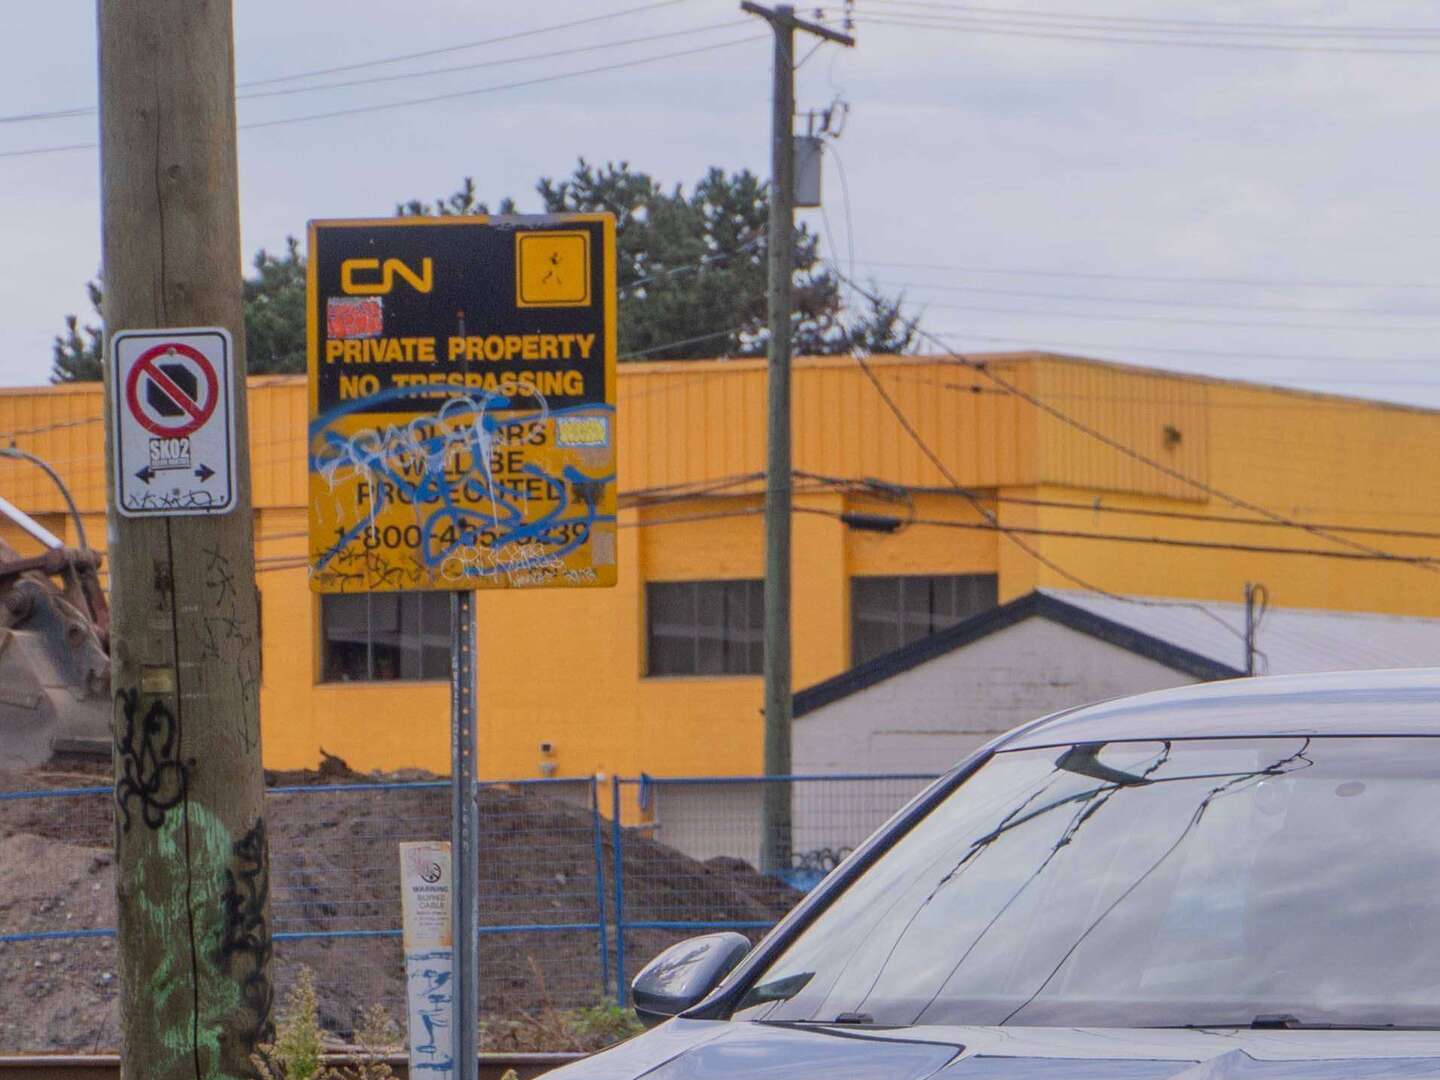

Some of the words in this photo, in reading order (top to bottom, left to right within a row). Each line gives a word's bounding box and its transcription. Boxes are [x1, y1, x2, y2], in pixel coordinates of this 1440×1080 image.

[341, 257, 433, 294] CN
[326, 337, 437, 364] PRIVATE
[447, 334, 595, 362] PROPERTY
[339, 374, 380, 400] NO
[393, 370, 584, 399] TRESPASSING
